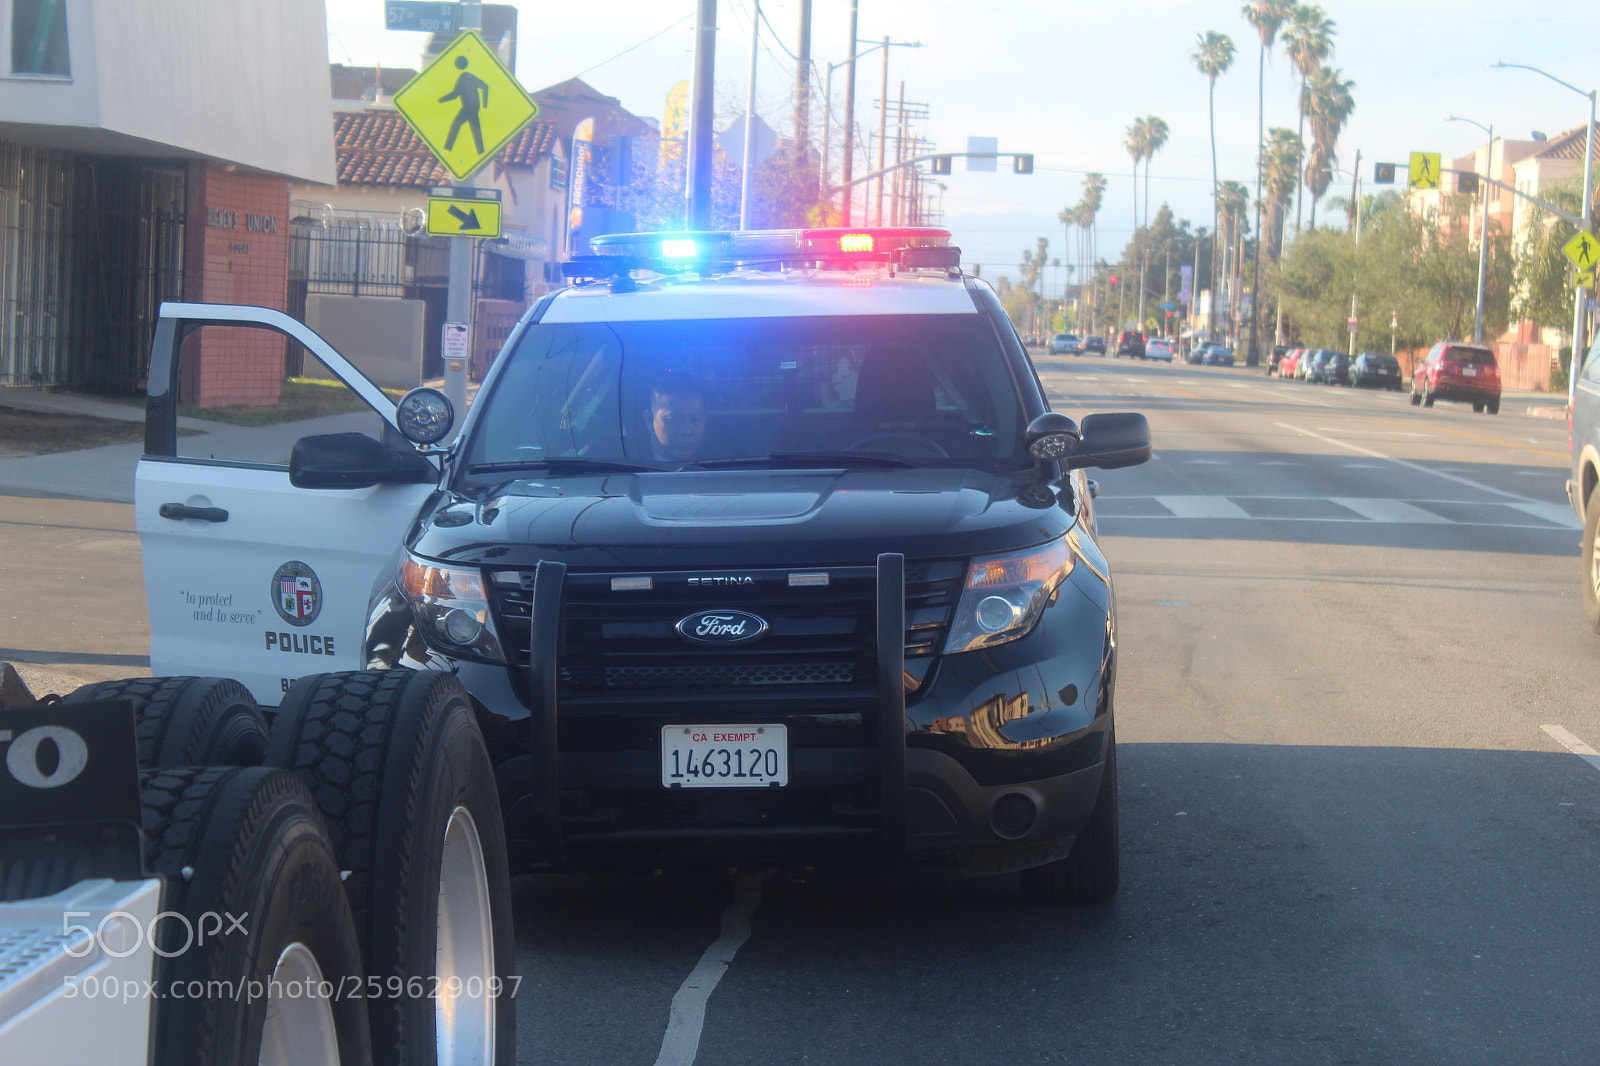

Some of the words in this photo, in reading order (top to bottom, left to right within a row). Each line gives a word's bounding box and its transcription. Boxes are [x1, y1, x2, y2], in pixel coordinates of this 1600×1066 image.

[420, 19, 439, 30] 500
[443, 20, 451, 30] W
[246, 214, 278, 233] UNION
[687, 577, 754, 586] SETINA
[198, 592, 233, 609] protect
[193, 607, 213, 622] and
[216, 609, 227, 623] to
[696, 615, 746, 636] Ford
[265, 631, 335, 656] POLICE
[692, 733, 708, 742] CA
[713, 733, 757, 742] EXEMPT
[671, 749, 778, 777] 1463120
